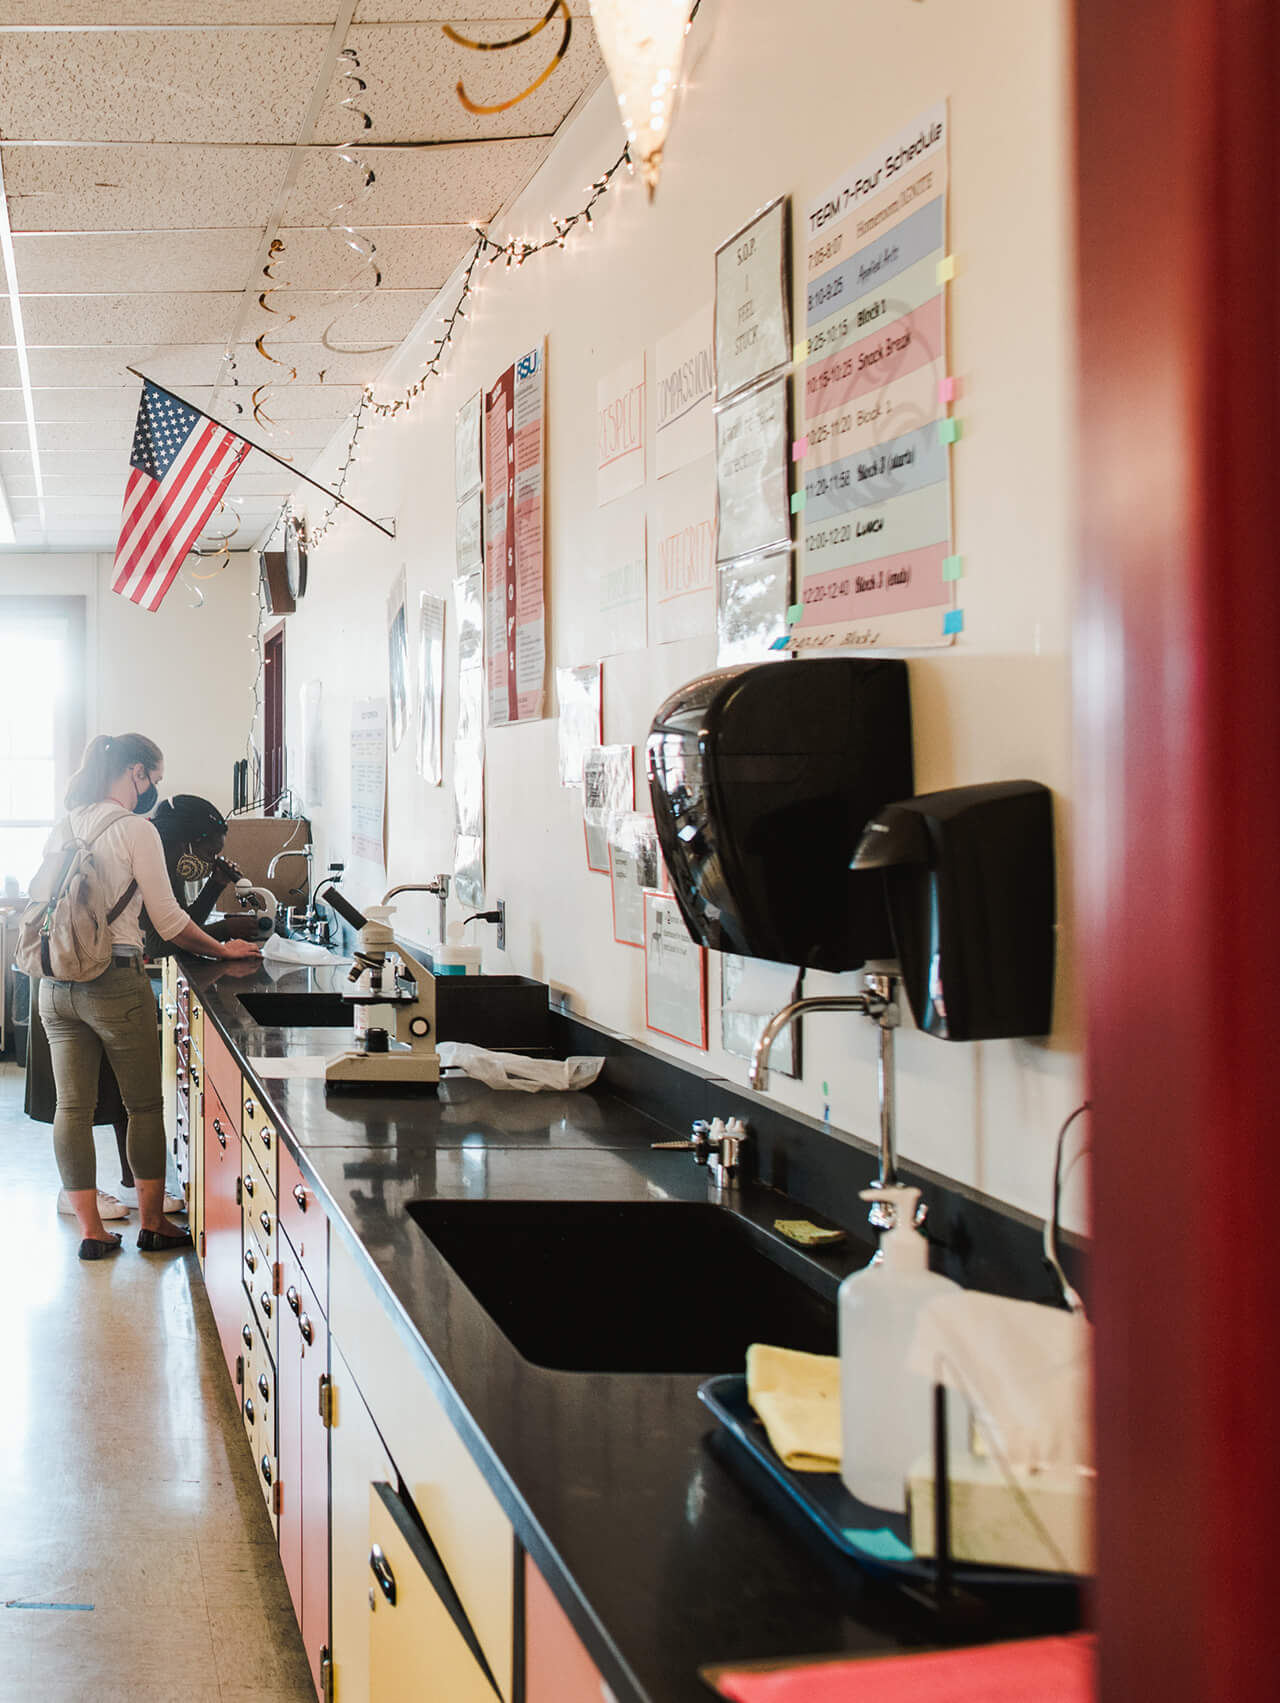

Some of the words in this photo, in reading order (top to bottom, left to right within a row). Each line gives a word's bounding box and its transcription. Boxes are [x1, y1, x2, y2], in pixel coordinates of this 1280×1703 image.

[809, 196, 840, 232] TEAM
[843, 168, 882, 208] 7-Four
[886, 122, 942, 178] Schedule
[857, 301, 881, 328] Block
[858, 346, 883, 371] Snack
[885, 328, 912, 357] Break
[600, 381, 646, 459] RESPECT
[857, 459, 878, 482] Block
[855, 573, 875, 594] Block
